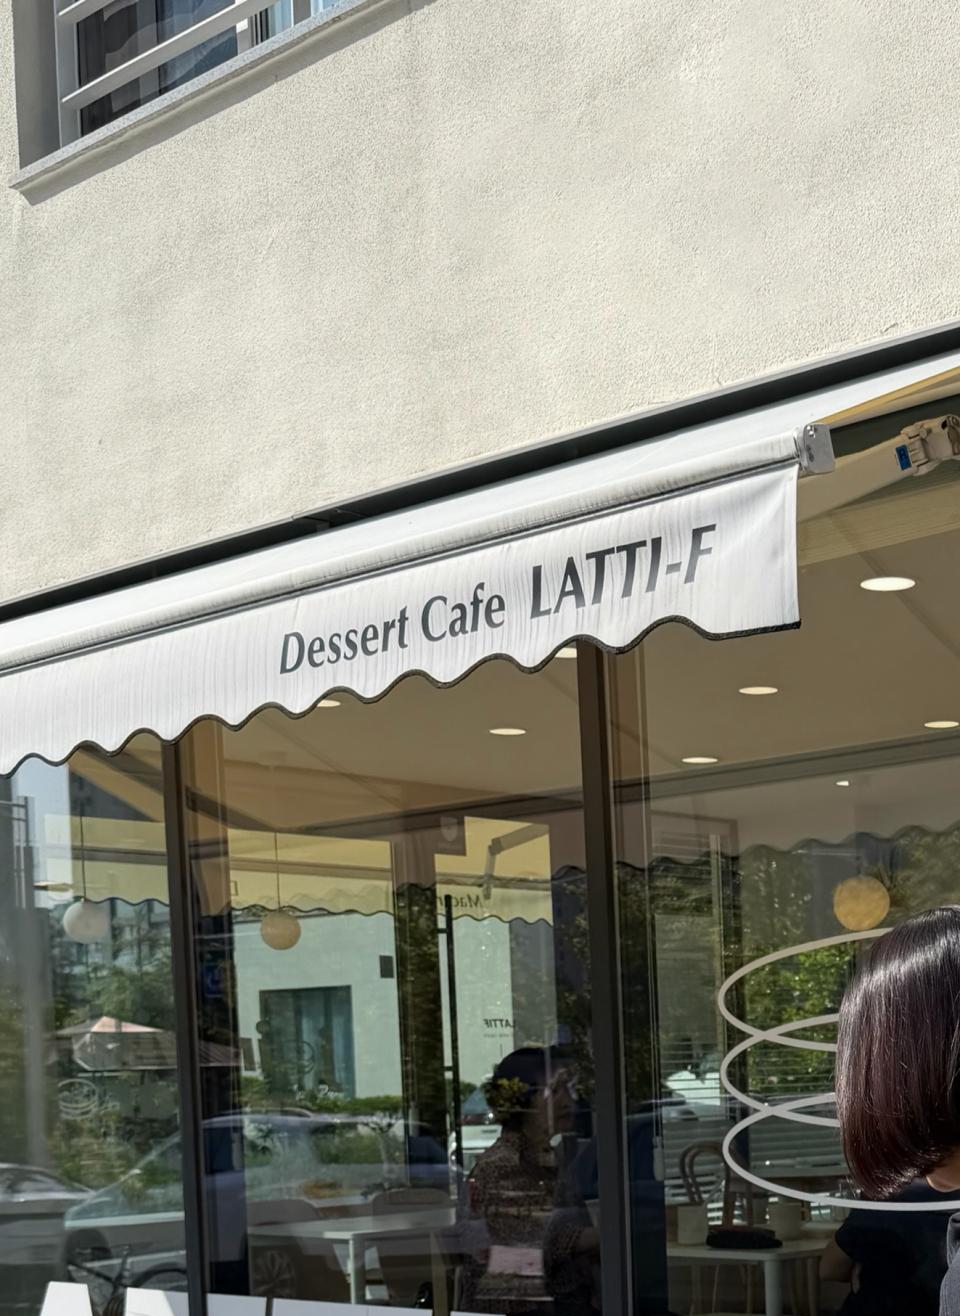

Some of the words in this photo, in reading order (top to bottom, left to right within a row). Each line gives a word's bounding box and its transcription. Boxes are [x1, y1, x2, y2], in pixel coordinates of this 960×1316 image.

[280, 605, 408, 674] Dessert
[421, 582, 506, 643] Cafe
[530, 524, 717, 619] LATTI-F
